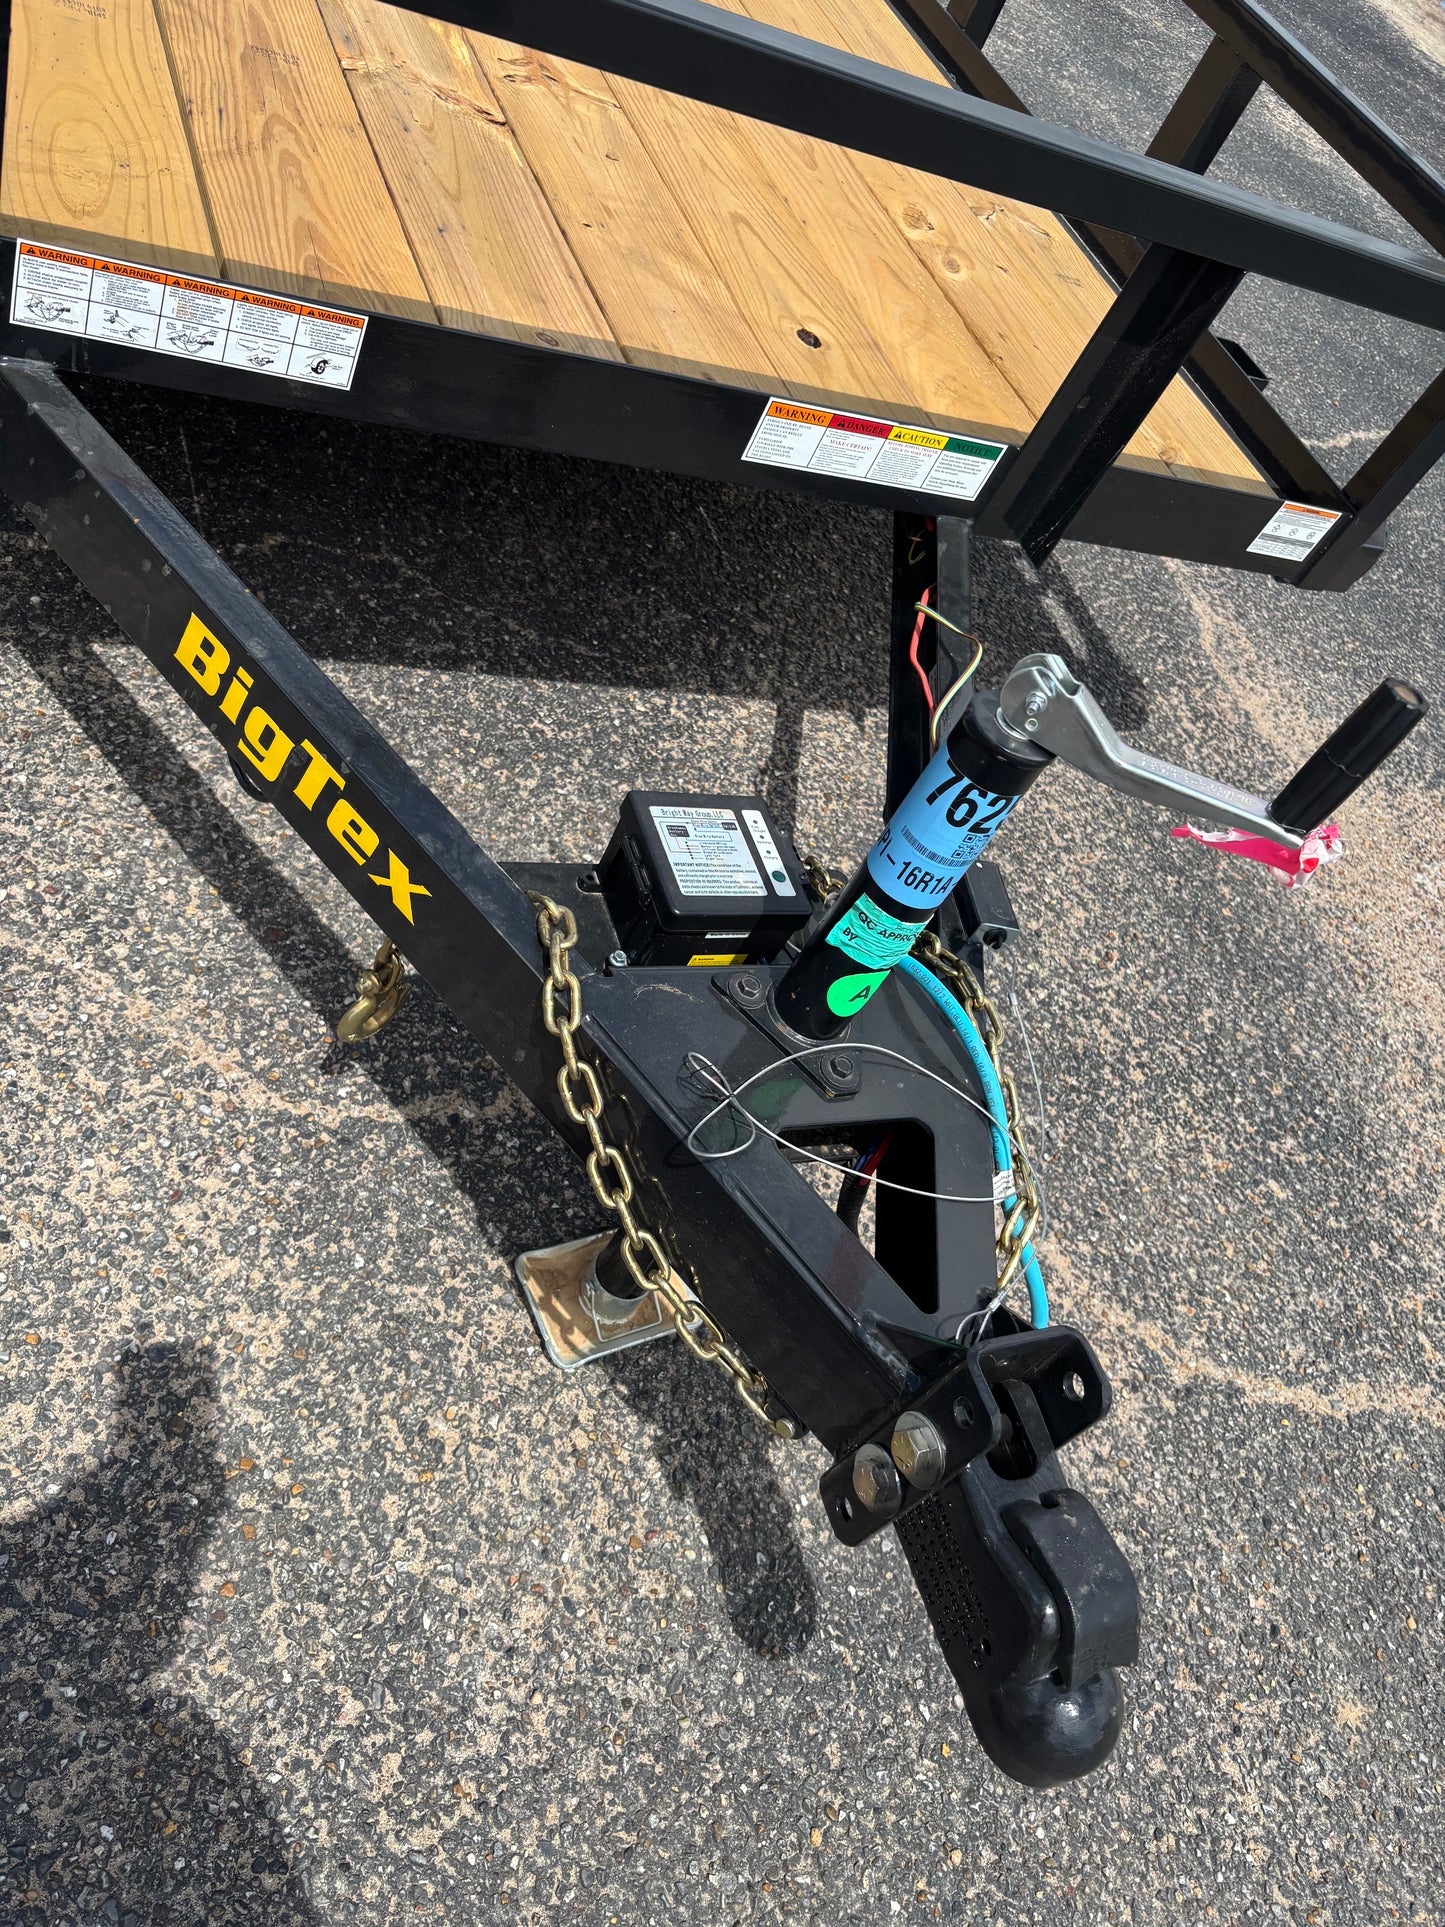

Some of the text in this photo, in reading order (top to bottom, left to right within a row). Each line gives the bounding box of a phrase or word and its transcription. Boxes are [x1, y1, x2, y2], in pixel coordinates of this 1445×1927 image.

[38, 249, 88, 265] WARNING
[112, 265, 160, 281] WARNING
[183, 281, 230, 296] WARNING
[252, 296, 296, 311] WARNING
[316, 311, 359, 325] WARNING
[772, 405, 826, 423] WARNING
[845, 421, 886, 435] DANGER
[901, 432, 943, 446] CAUTION
[954, 443, 991, 456] NOTICE
[174, 611, 433, 926] BigTex
[926, 758, 1022, 835] 762
[660, 808, 681, 816] Bright
[681, 809, 694, 818] Way
[858, 911, 878, 931] QC
[848, 985, 872, 1004] A
